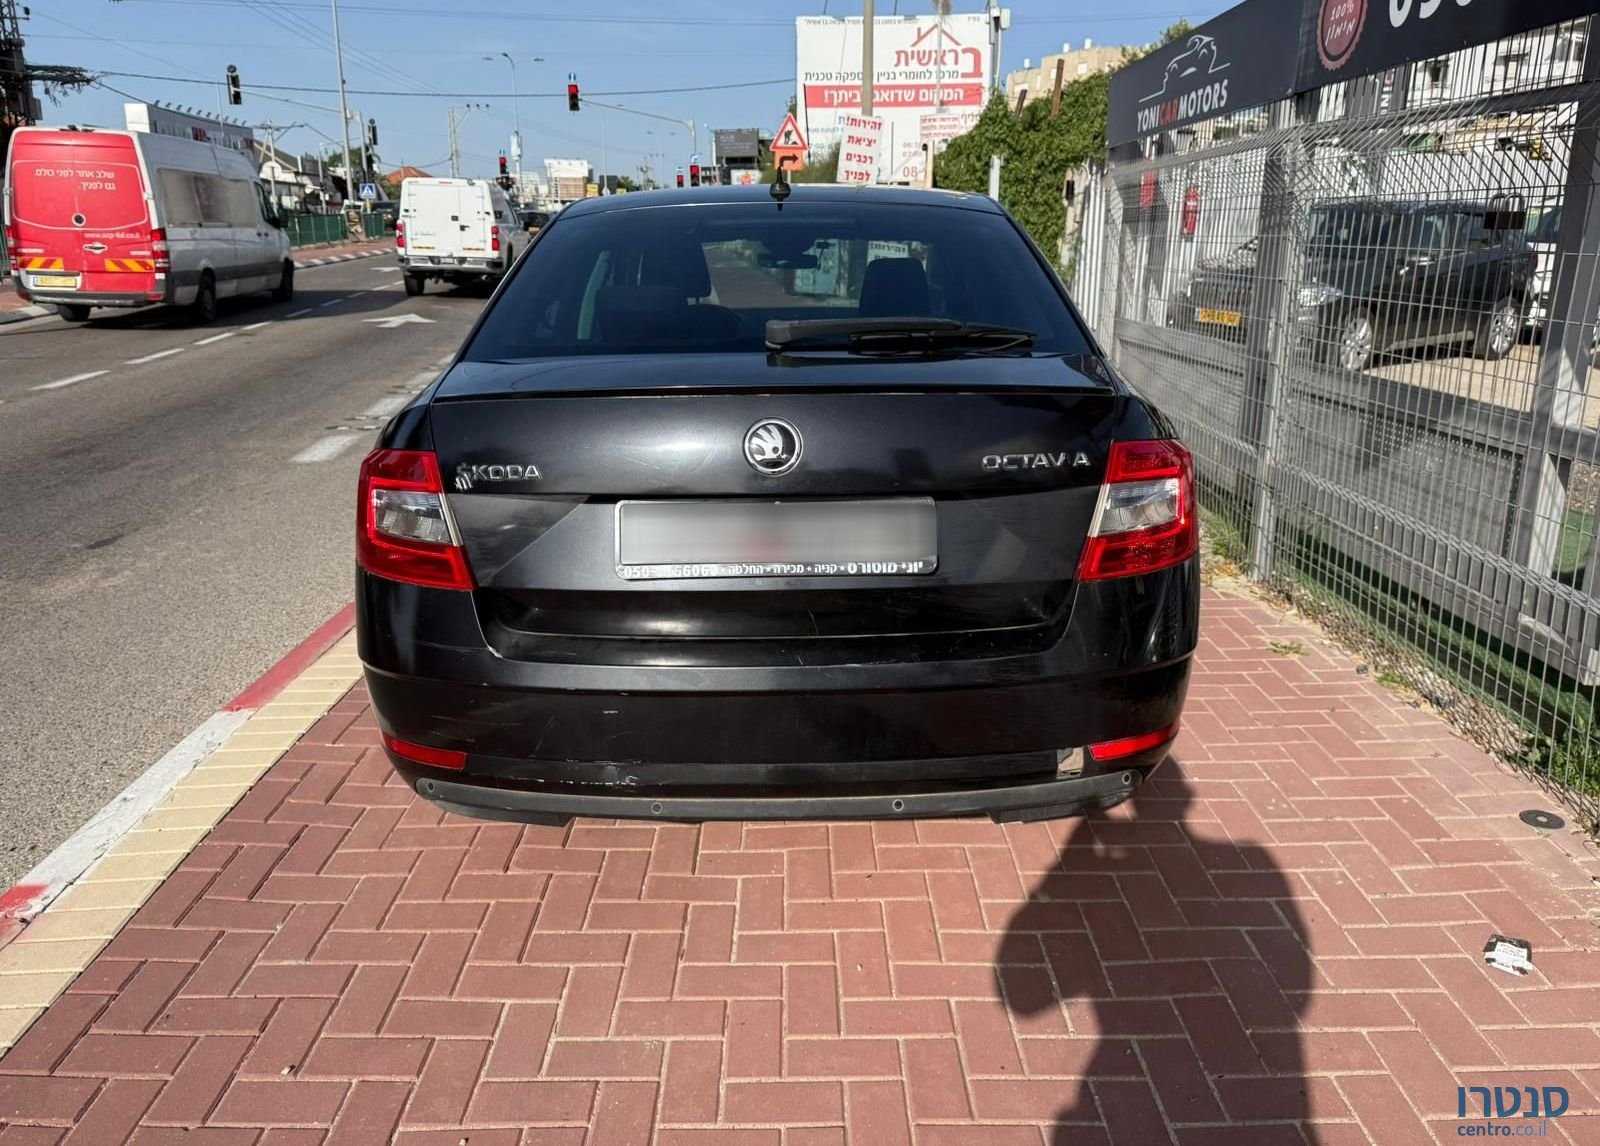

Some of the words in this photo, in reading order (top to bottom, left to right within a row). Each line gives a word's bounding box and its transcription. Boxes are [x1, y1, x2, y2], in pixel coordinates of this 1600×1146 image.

[1330, 0, 1355, 21] 100%
[894, 47, 983, 79] בראשית
[804, 71, 833, 82] טכנית
[835, 72, 863, 83] ספקה
[876, 71, 897, 83] בניין
[899, 68, 932, 81] לחומרי
[824, 89, 862, 105] ביתך!
[873, 89, 915, 103] שדואג
[919, 88, 963, 104] המקום
[846, 116, 882, 131] זהירות!
[847, 135, 877, 147] יציאת
[846, 152, 873, 165] רכבים
[56, 168, 74, 178] לפני
[95, 169, 115, 179] שלב
[844, 169, 871, 181] לפניך
[104, 182, 116, 190] גם
[982, 452, 1091, 469] OCTAVA
[727, 564, 764, 575] החלפה
[773, 564, 804, 574] מכירה
[814, 563, 837, 574] קניה
[847, 562, 898, 574] מוטורס
